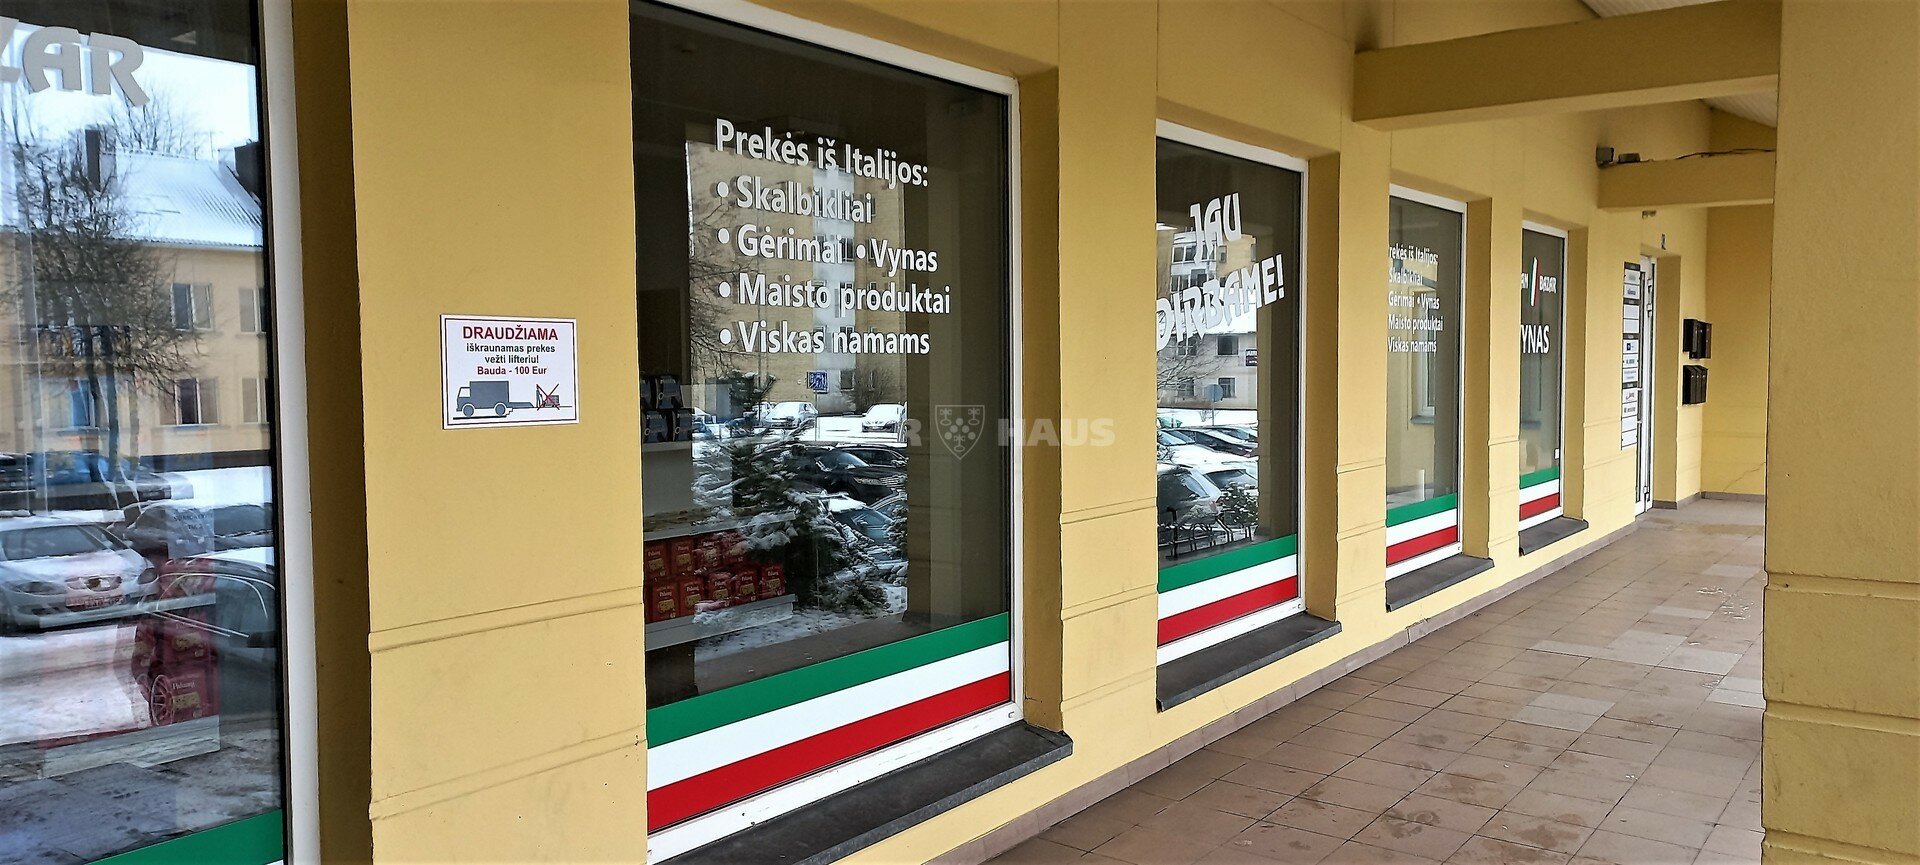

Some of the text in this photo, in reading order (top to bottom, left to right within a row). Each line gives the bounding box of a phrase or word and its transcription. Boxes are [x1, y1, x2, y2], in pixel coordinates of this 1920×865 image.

[716, 118, 929, 190] Prekės iš Italijos:
[736, 174, 872, 223] Skalbikliai
[1190, 192, 1242, 267] JAU
[737, 223, 938, 277] Gėrimai Vynas
[1408, 246, 1415, 261] iš
[1415, 246, 1438, 268] Italijos:
[1388, 267, 1423, 286] Skalbikliai
[739, 272, 951, 318] Maisto produktai
[1156, 254, 1285, 352] DIRBAME!
[1388, 290, 1440, 312] Gėrimai Vynas
[463, 325, 558, 341] DRAUDŽIAMA
[1388, 314, 1443, 334] Maisto produktai
[466, 343, 555, 354] iškraunamas prekes
[738, 320, 930, 355] Viskas namams
[1387, 336, 1437, 353] Viskas namams
[485, 354, 539, 364] vežti lifteriu!
[477, 366, 506, 375] Bauda
[515, 366, 530, 375] 100
[532, 367, 547, 375] Eur
